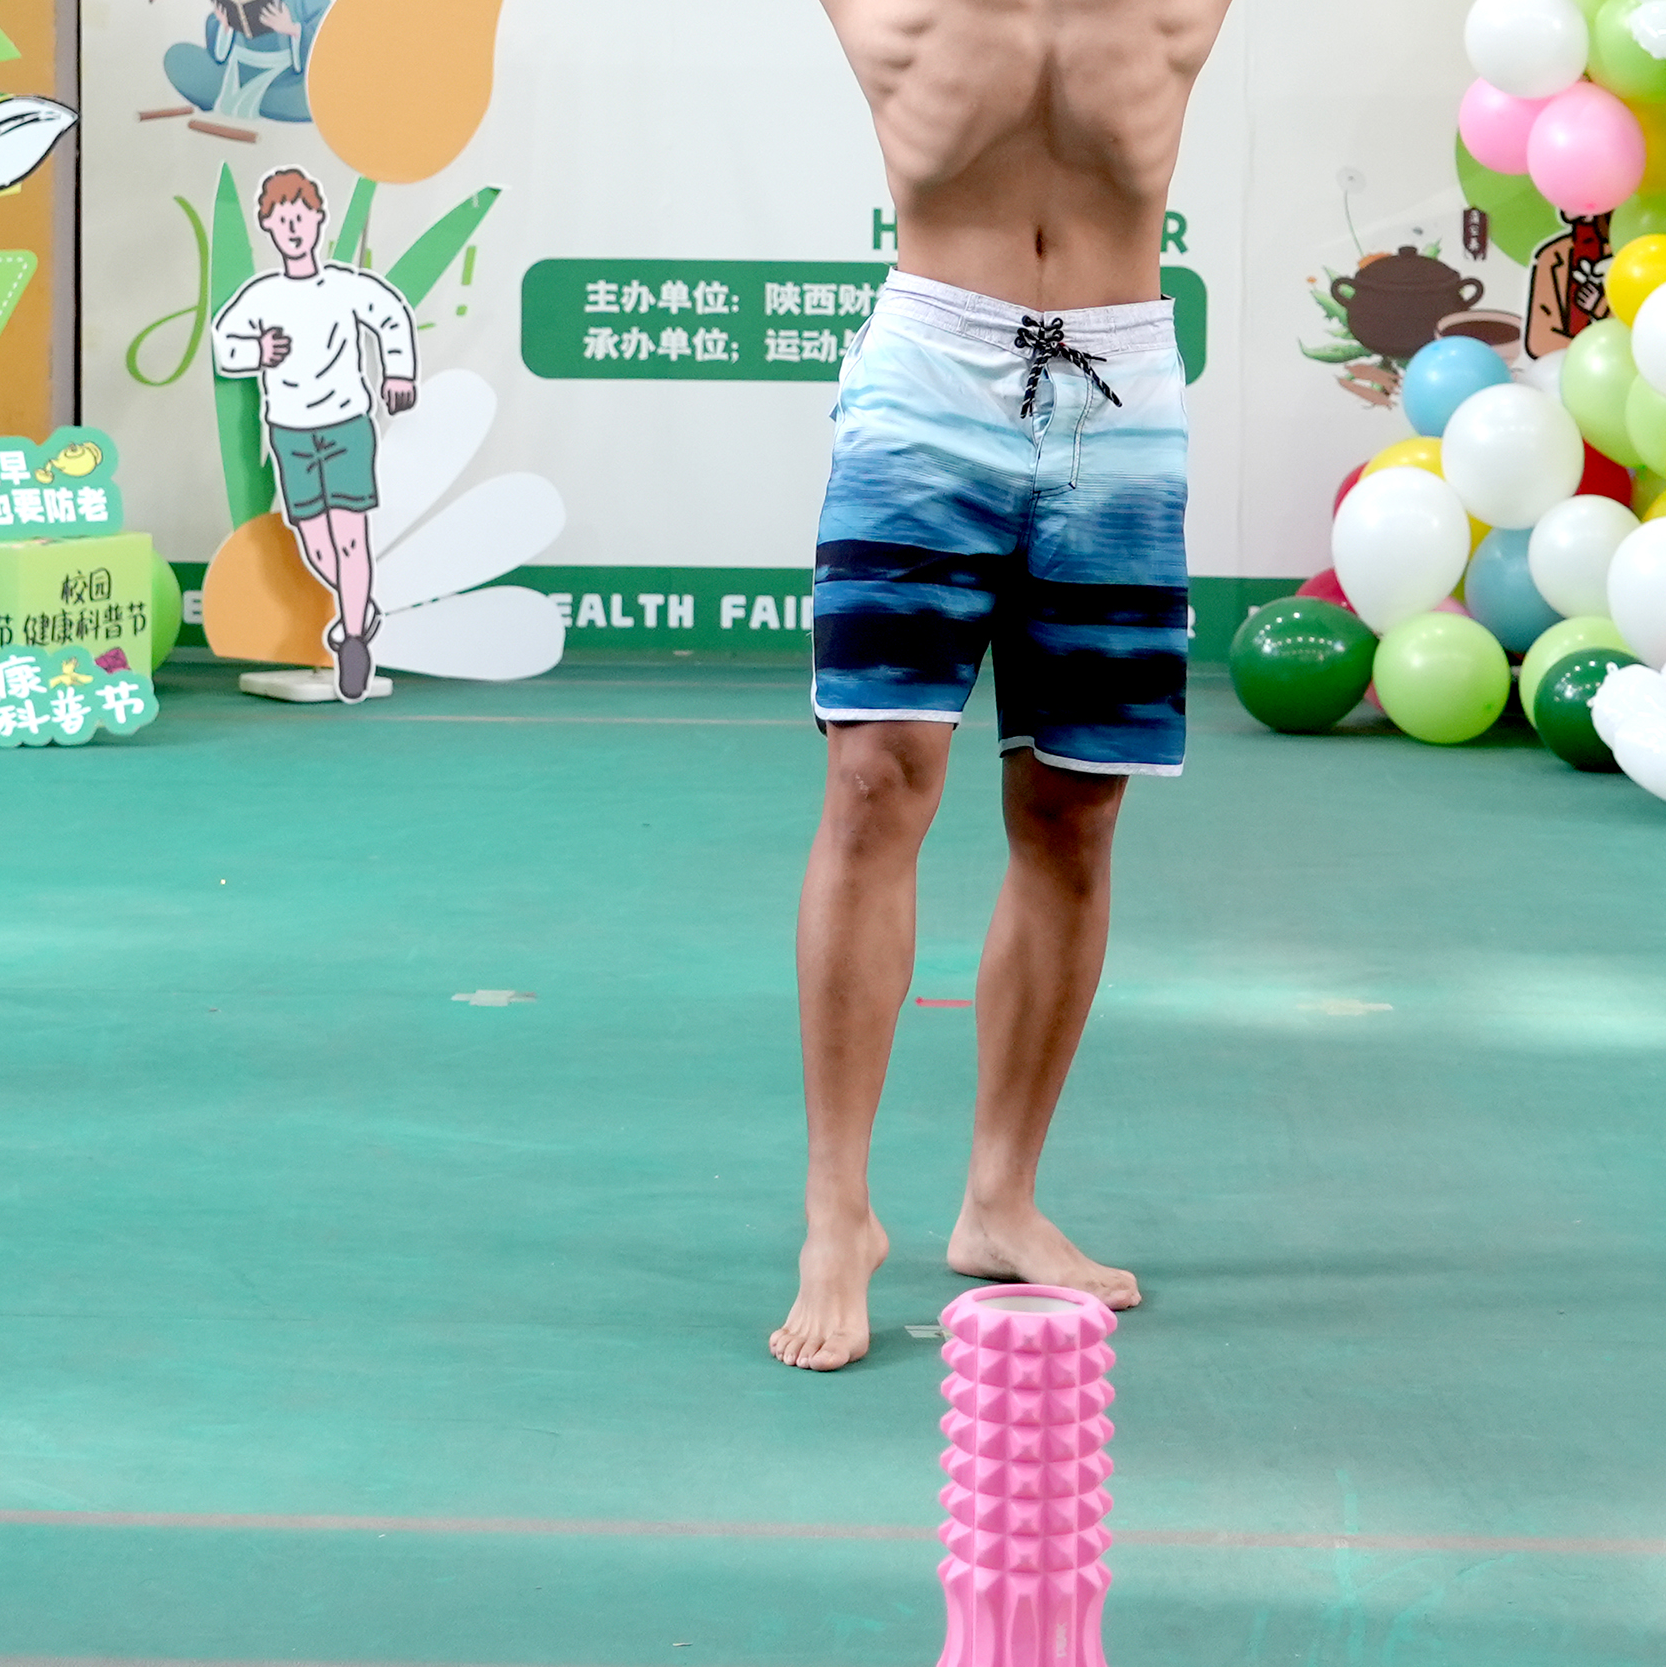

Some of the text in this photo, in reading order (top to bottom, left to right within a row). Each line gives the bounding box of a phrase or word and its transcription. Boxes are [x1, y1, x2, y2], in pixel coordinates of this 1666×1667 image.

[764, 281, 885, 317] 陕西财
[60, 567, 112, 605] 校园
[23, 601, 147, 647] 健康科普节
[548, 592, 695, 629] EALTH
